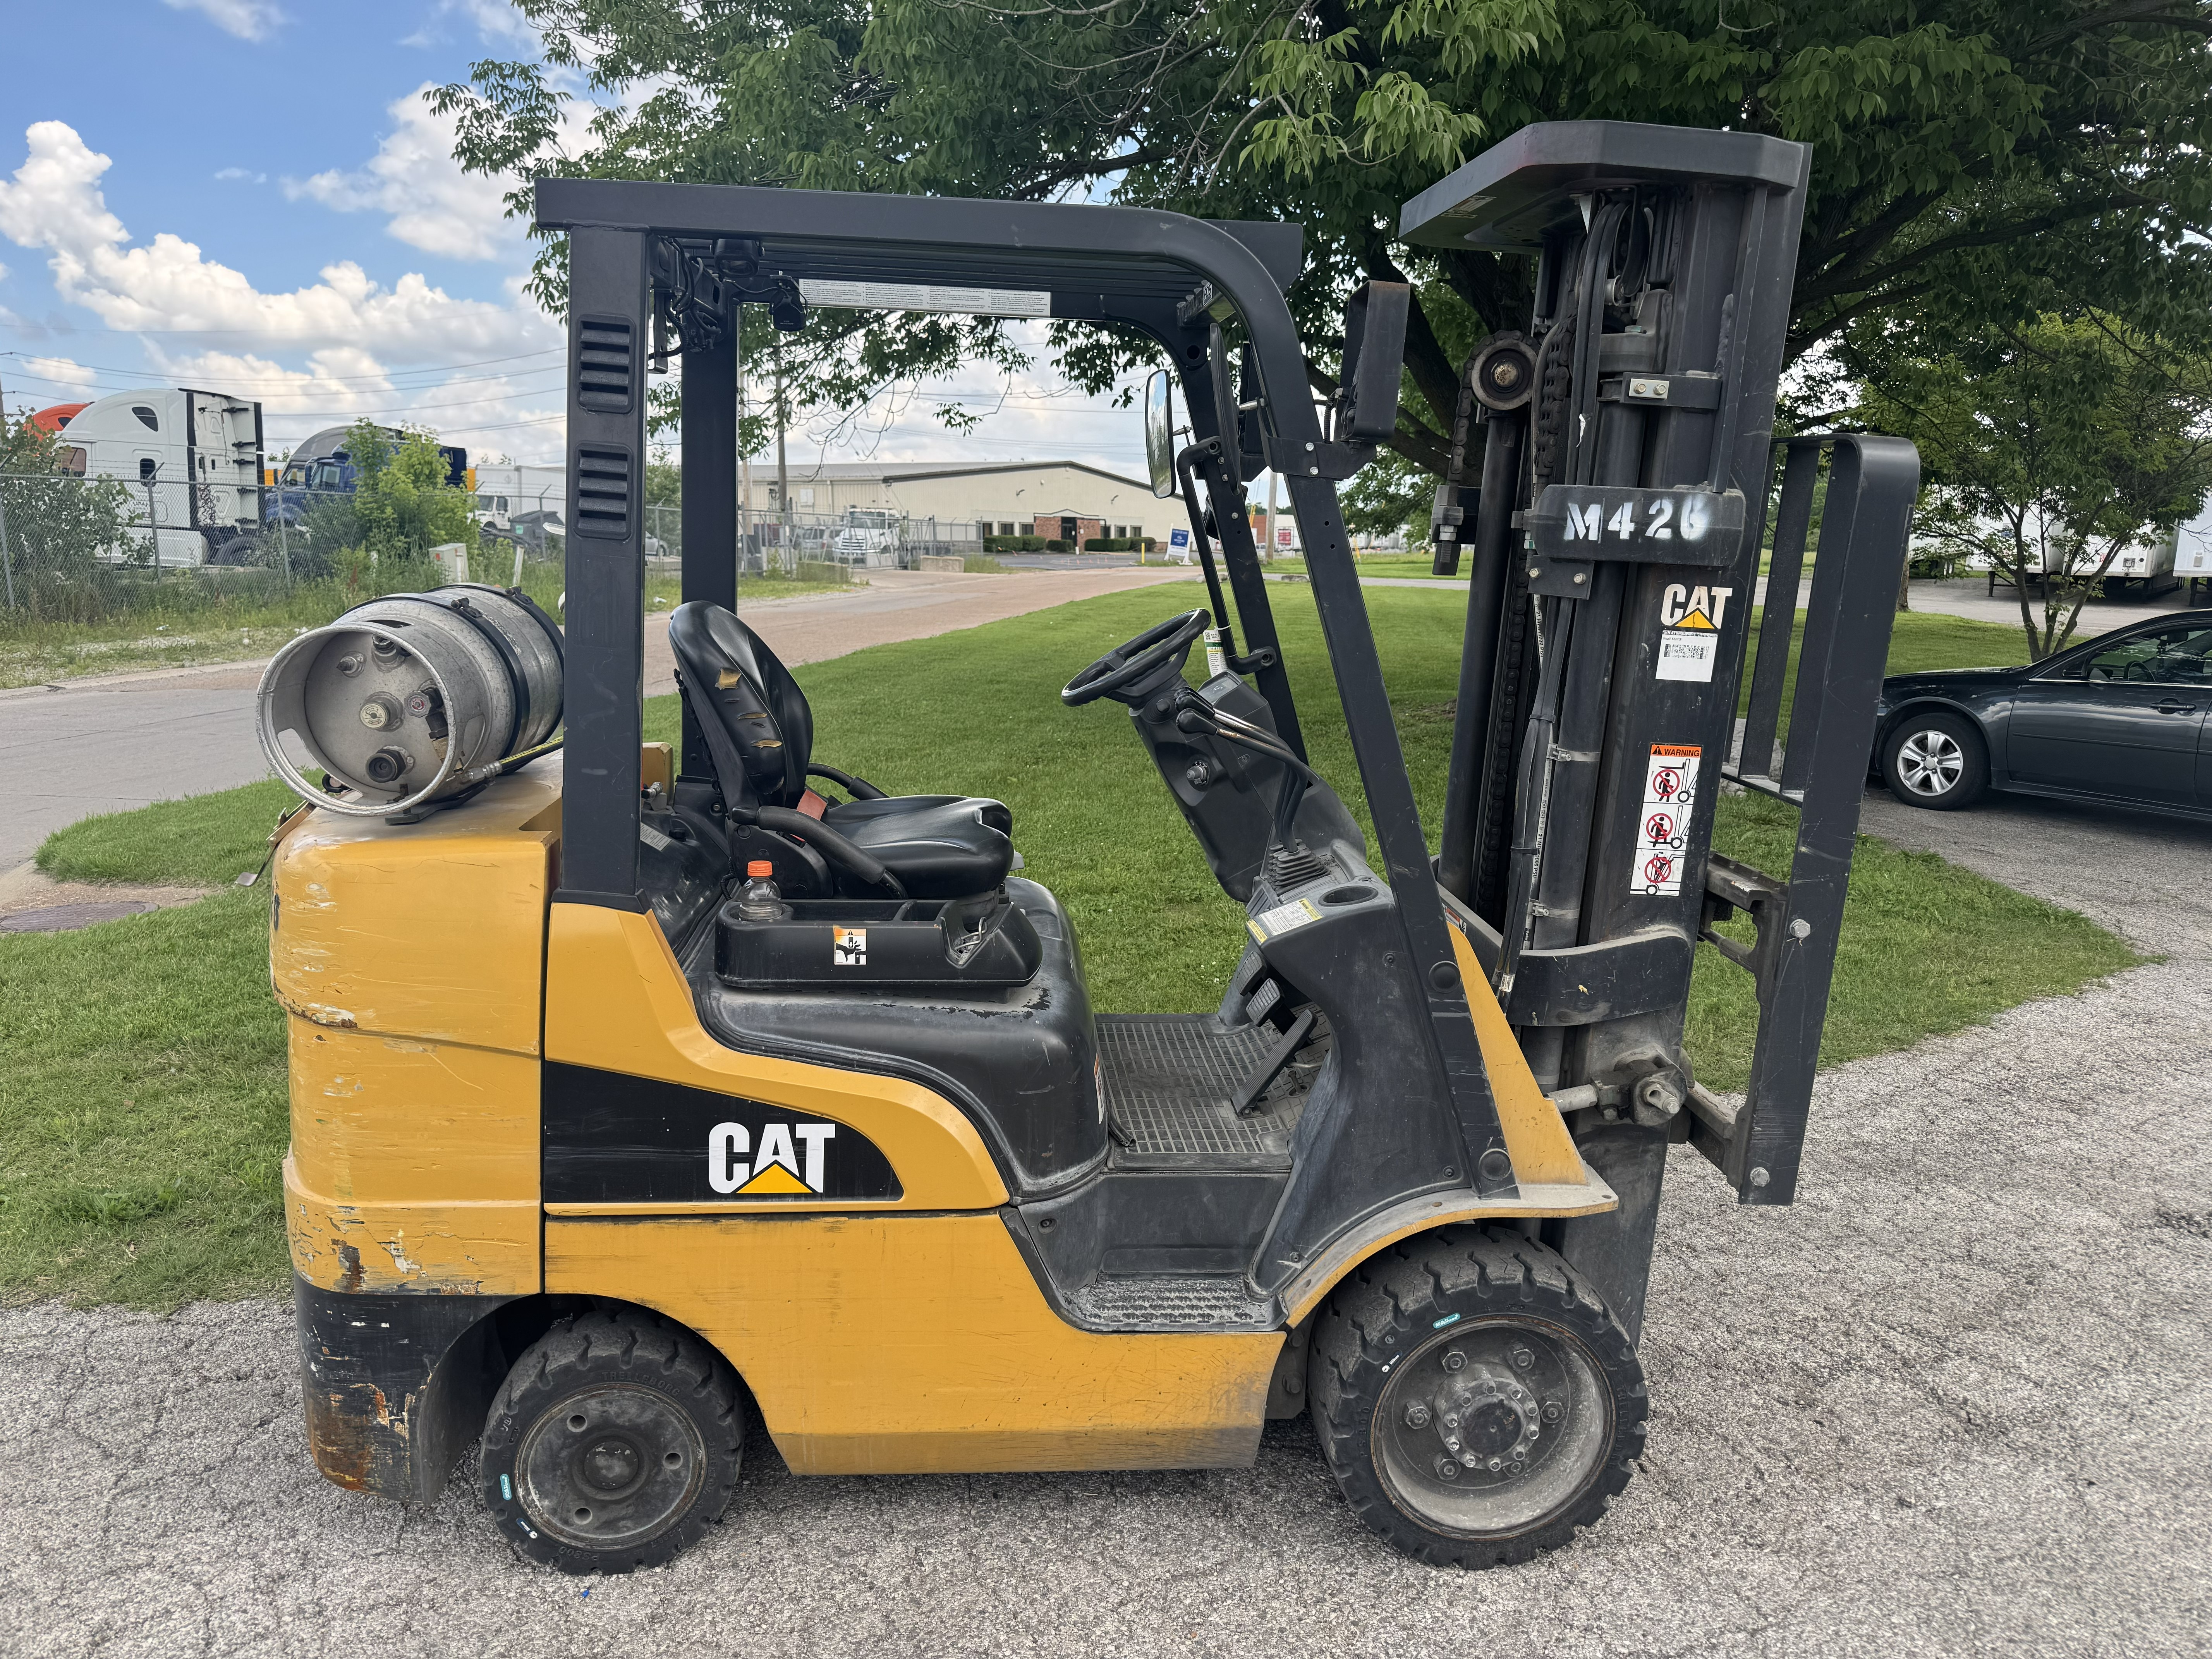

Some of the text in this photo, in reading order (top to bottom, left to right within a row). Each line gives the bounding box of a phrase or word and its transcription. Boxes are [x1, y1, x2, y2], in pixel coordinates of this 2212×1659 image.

[1661, 584, 1732, 629] CAT
[1664, 748, 1700, 757] WARNING
[709, 1122, 835, 1194] CAT
[601, 1371, 680, 1397] TRELLEBORG
